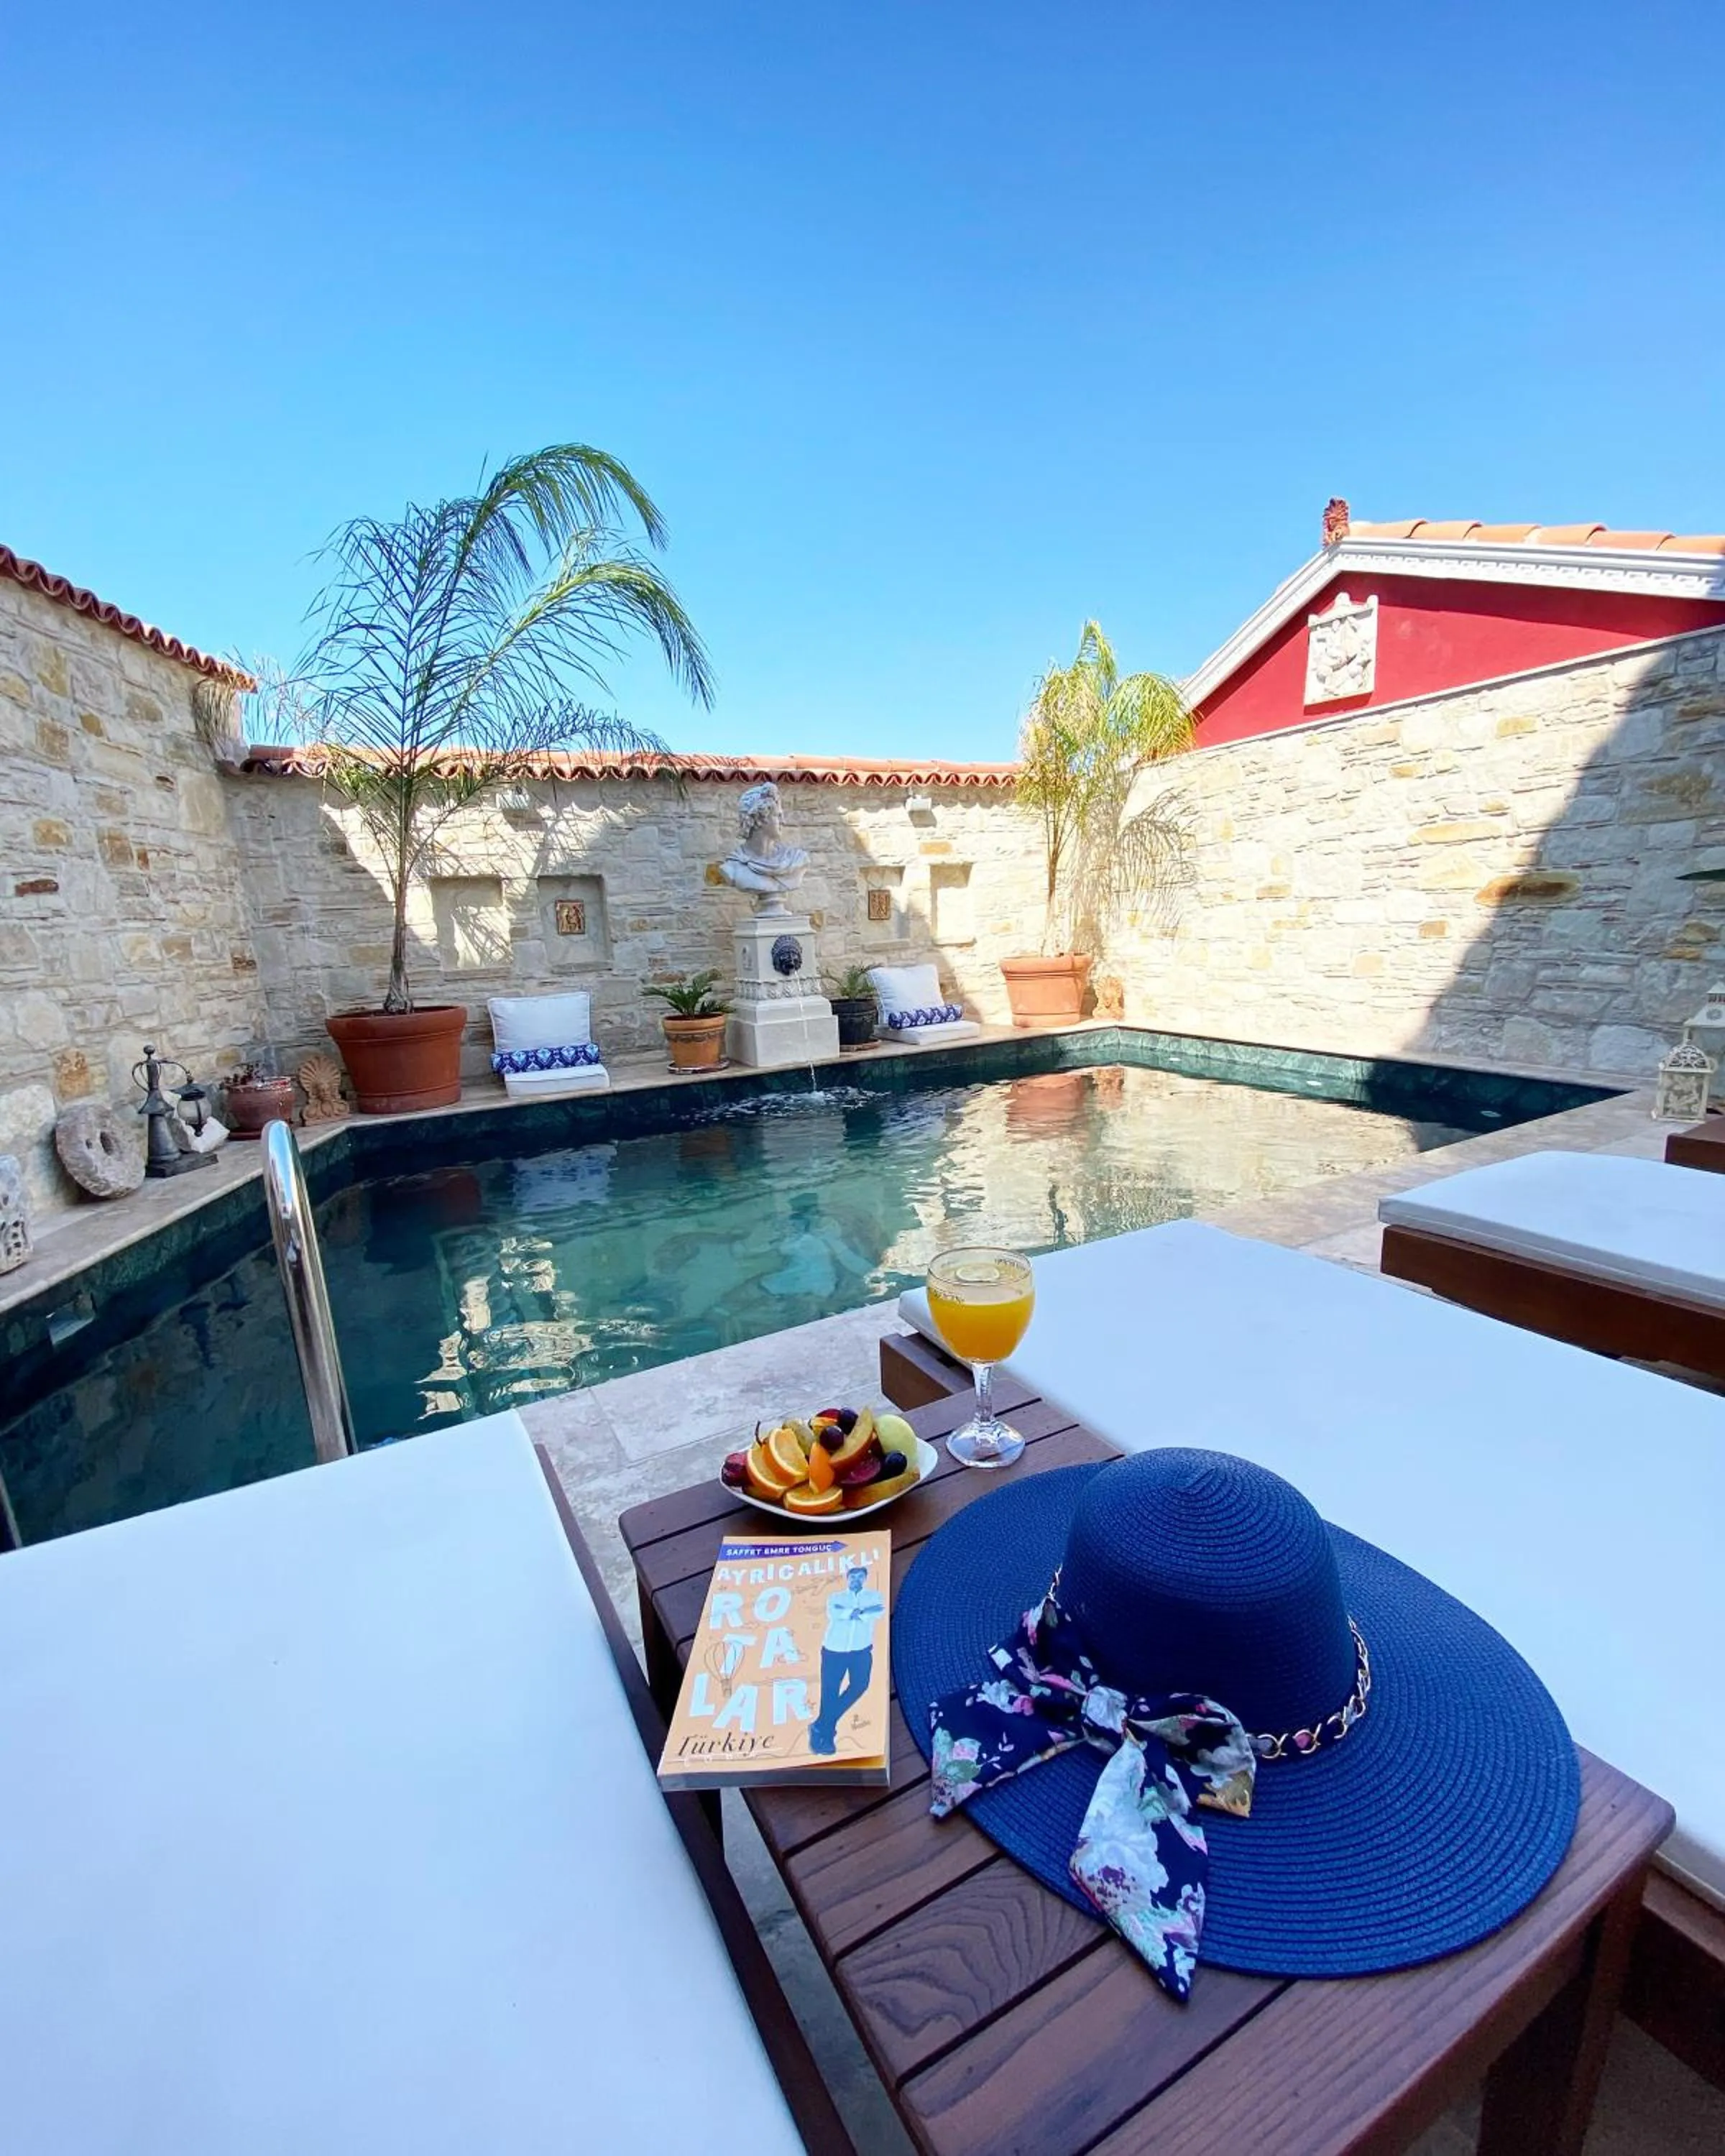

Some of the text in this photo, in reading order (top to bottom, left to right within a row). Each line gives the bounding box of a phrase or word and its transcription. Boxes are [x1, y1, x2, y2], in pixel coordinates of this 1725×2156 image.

[726, 1544, 832, 1556] SAFFET EMRE TONGUÇ
[717, 1548, 880, 1585] AYRICALIKLI
[689, 1672, 812, 1733] LAR
[678, 1731, 775, 1757] Türkiye
